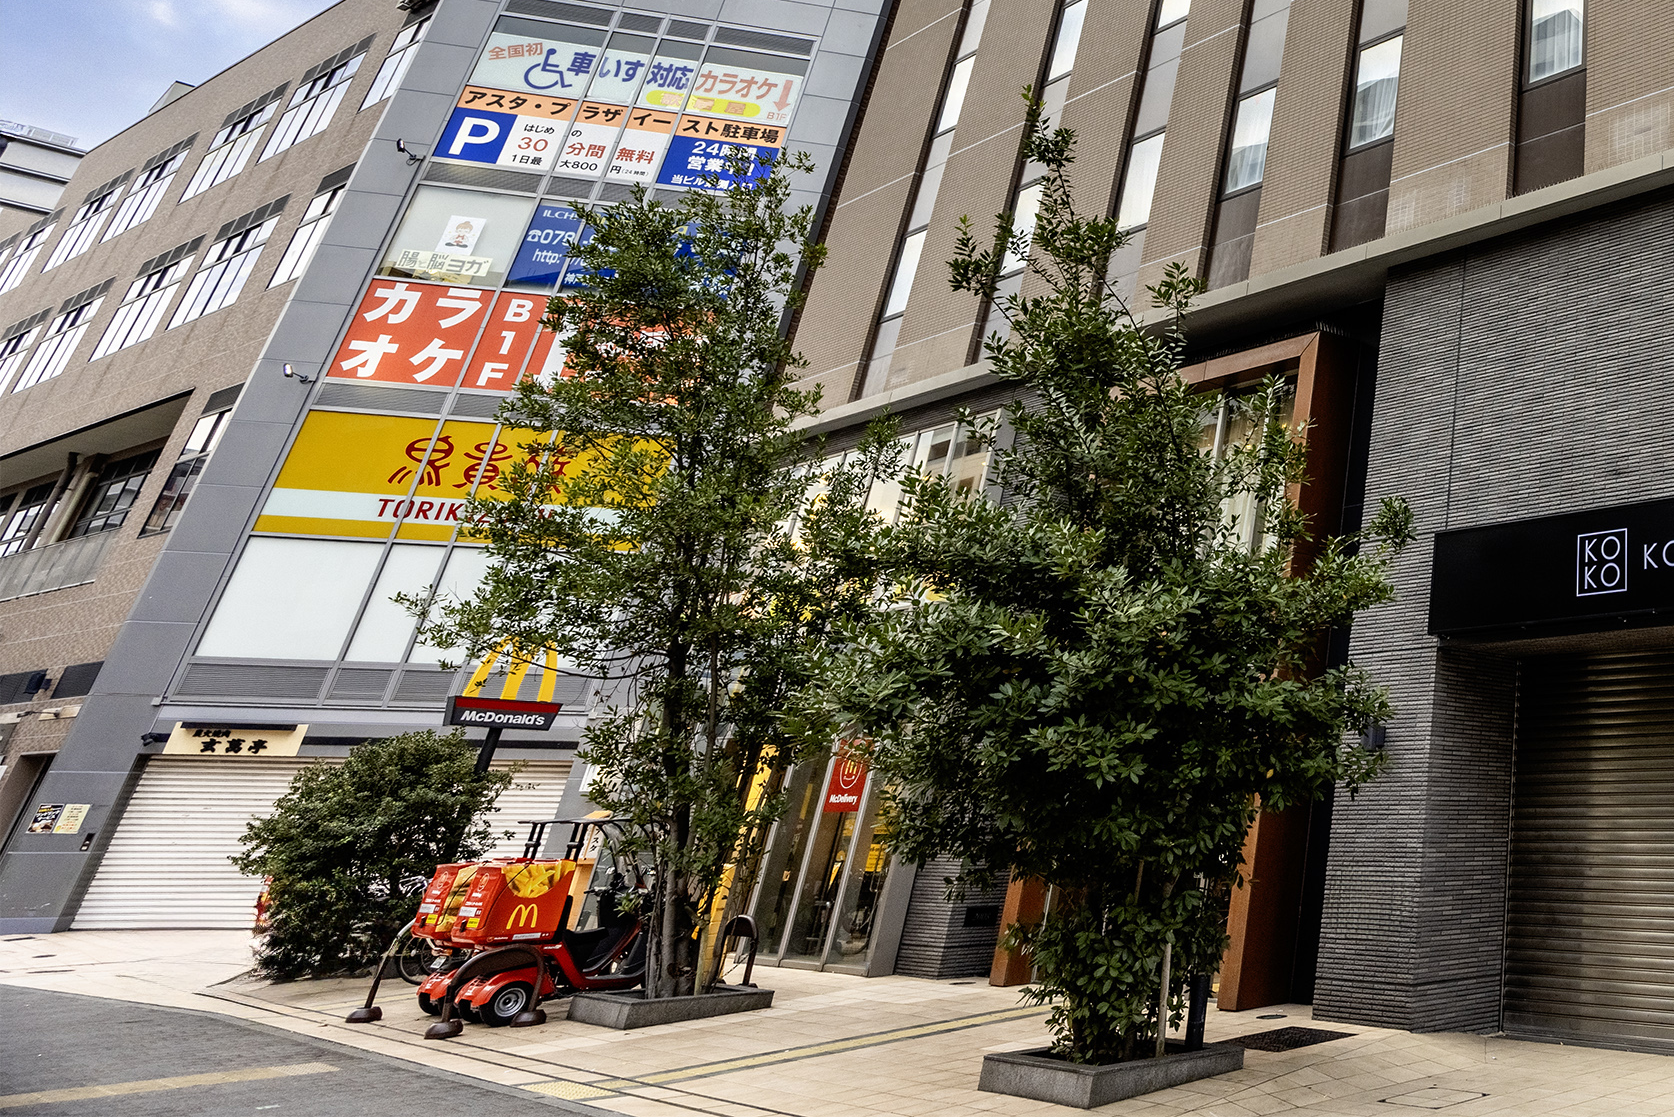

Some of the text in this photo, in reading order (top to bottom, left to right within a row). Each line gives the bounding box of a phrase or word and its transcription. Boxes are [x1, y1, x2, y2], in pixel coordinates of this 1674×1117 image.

[488, 42, 543, 60] 全国初
[767, 112, 787, 120] B1F
[448, 116, 500, 156] P
[398, 251, 489, 274] 腸と脳ヨガ
[460, 710, 545, 725] McDonald's
[828, 793, 858, 805] McDelivery
